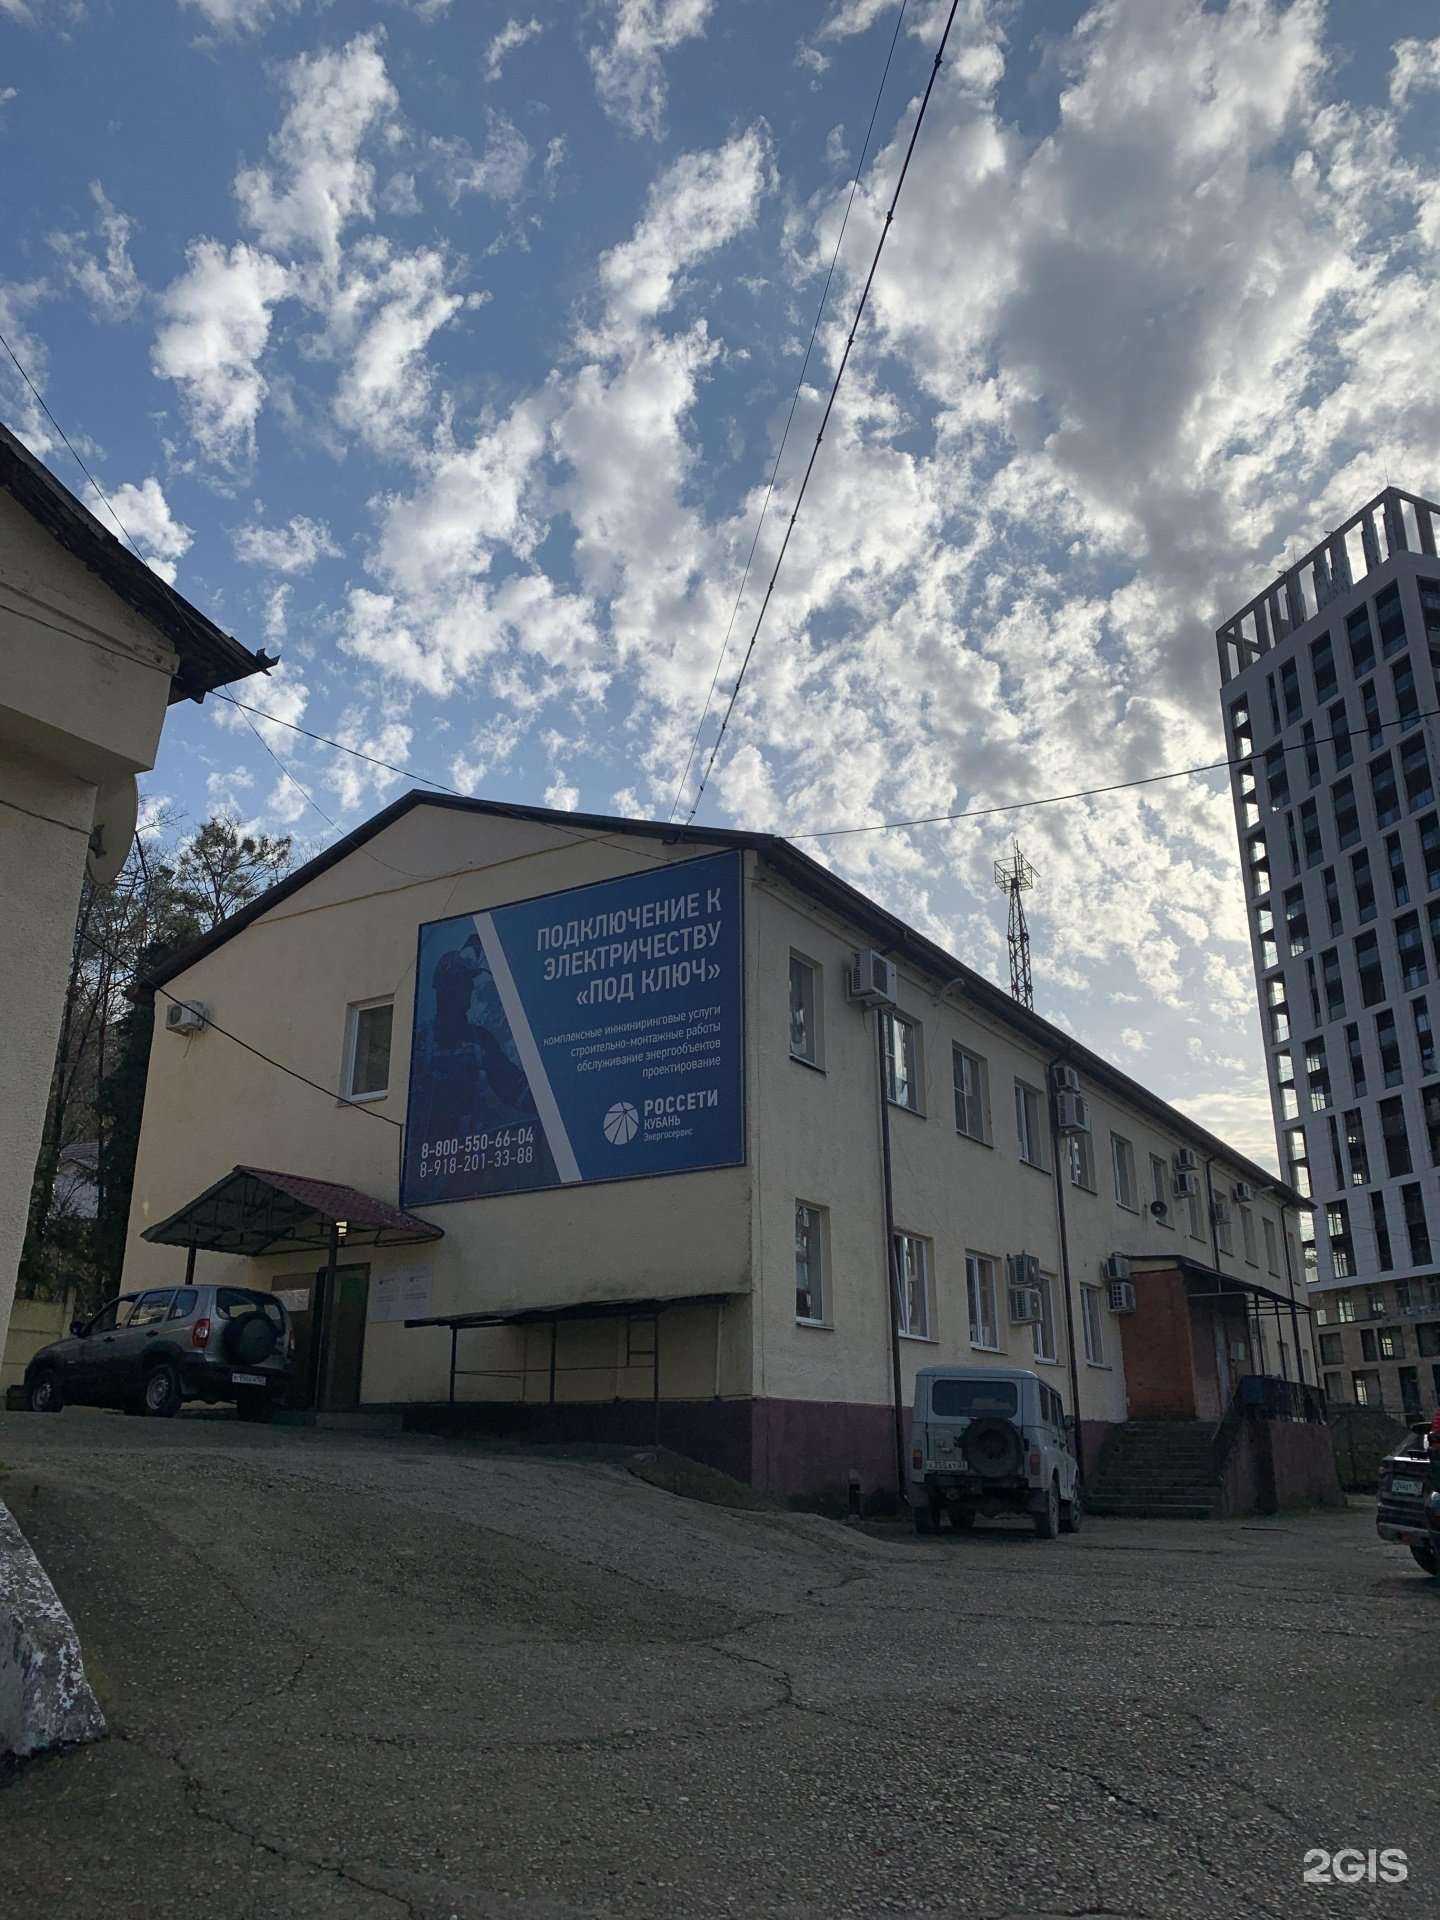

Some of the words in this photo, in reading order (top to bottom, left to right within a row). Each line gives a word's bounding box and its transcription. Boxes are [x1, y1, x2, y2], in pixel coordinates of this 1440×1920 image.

[537, 892, 700, 951] ПОДКЛЮЧЕНИЕ
[707, 887, 722, 913] К
[543, 920, 722, 981] ЭЛЕКТРИЧЕСТВУ
[576, 973, 635, 1005] «ПОД
[641, 957, 721, 994] КЛЮЧ»
[543, 1027, 603, 1047] комплексные
[688, 1005, 721, 1023] услуги
[570, 1029, 684, 1057] строительно-монтажные
[686, 1022, 721, 1037] работы
[577, 1053, 644, 1072] обслуживание
[645, 1038, 721, 1061] энергообъектов
[642, 1056, 721, 1079] проектирование
[644, 1088, 719, 1117] РОССЕТИ
[644, 1115, 681, 1130] КУБАНЬ
[421, 1126, 534, 1159] 8-800-550-66-04
[420, 1146, 533, 1178] 8-918-201-33-88
